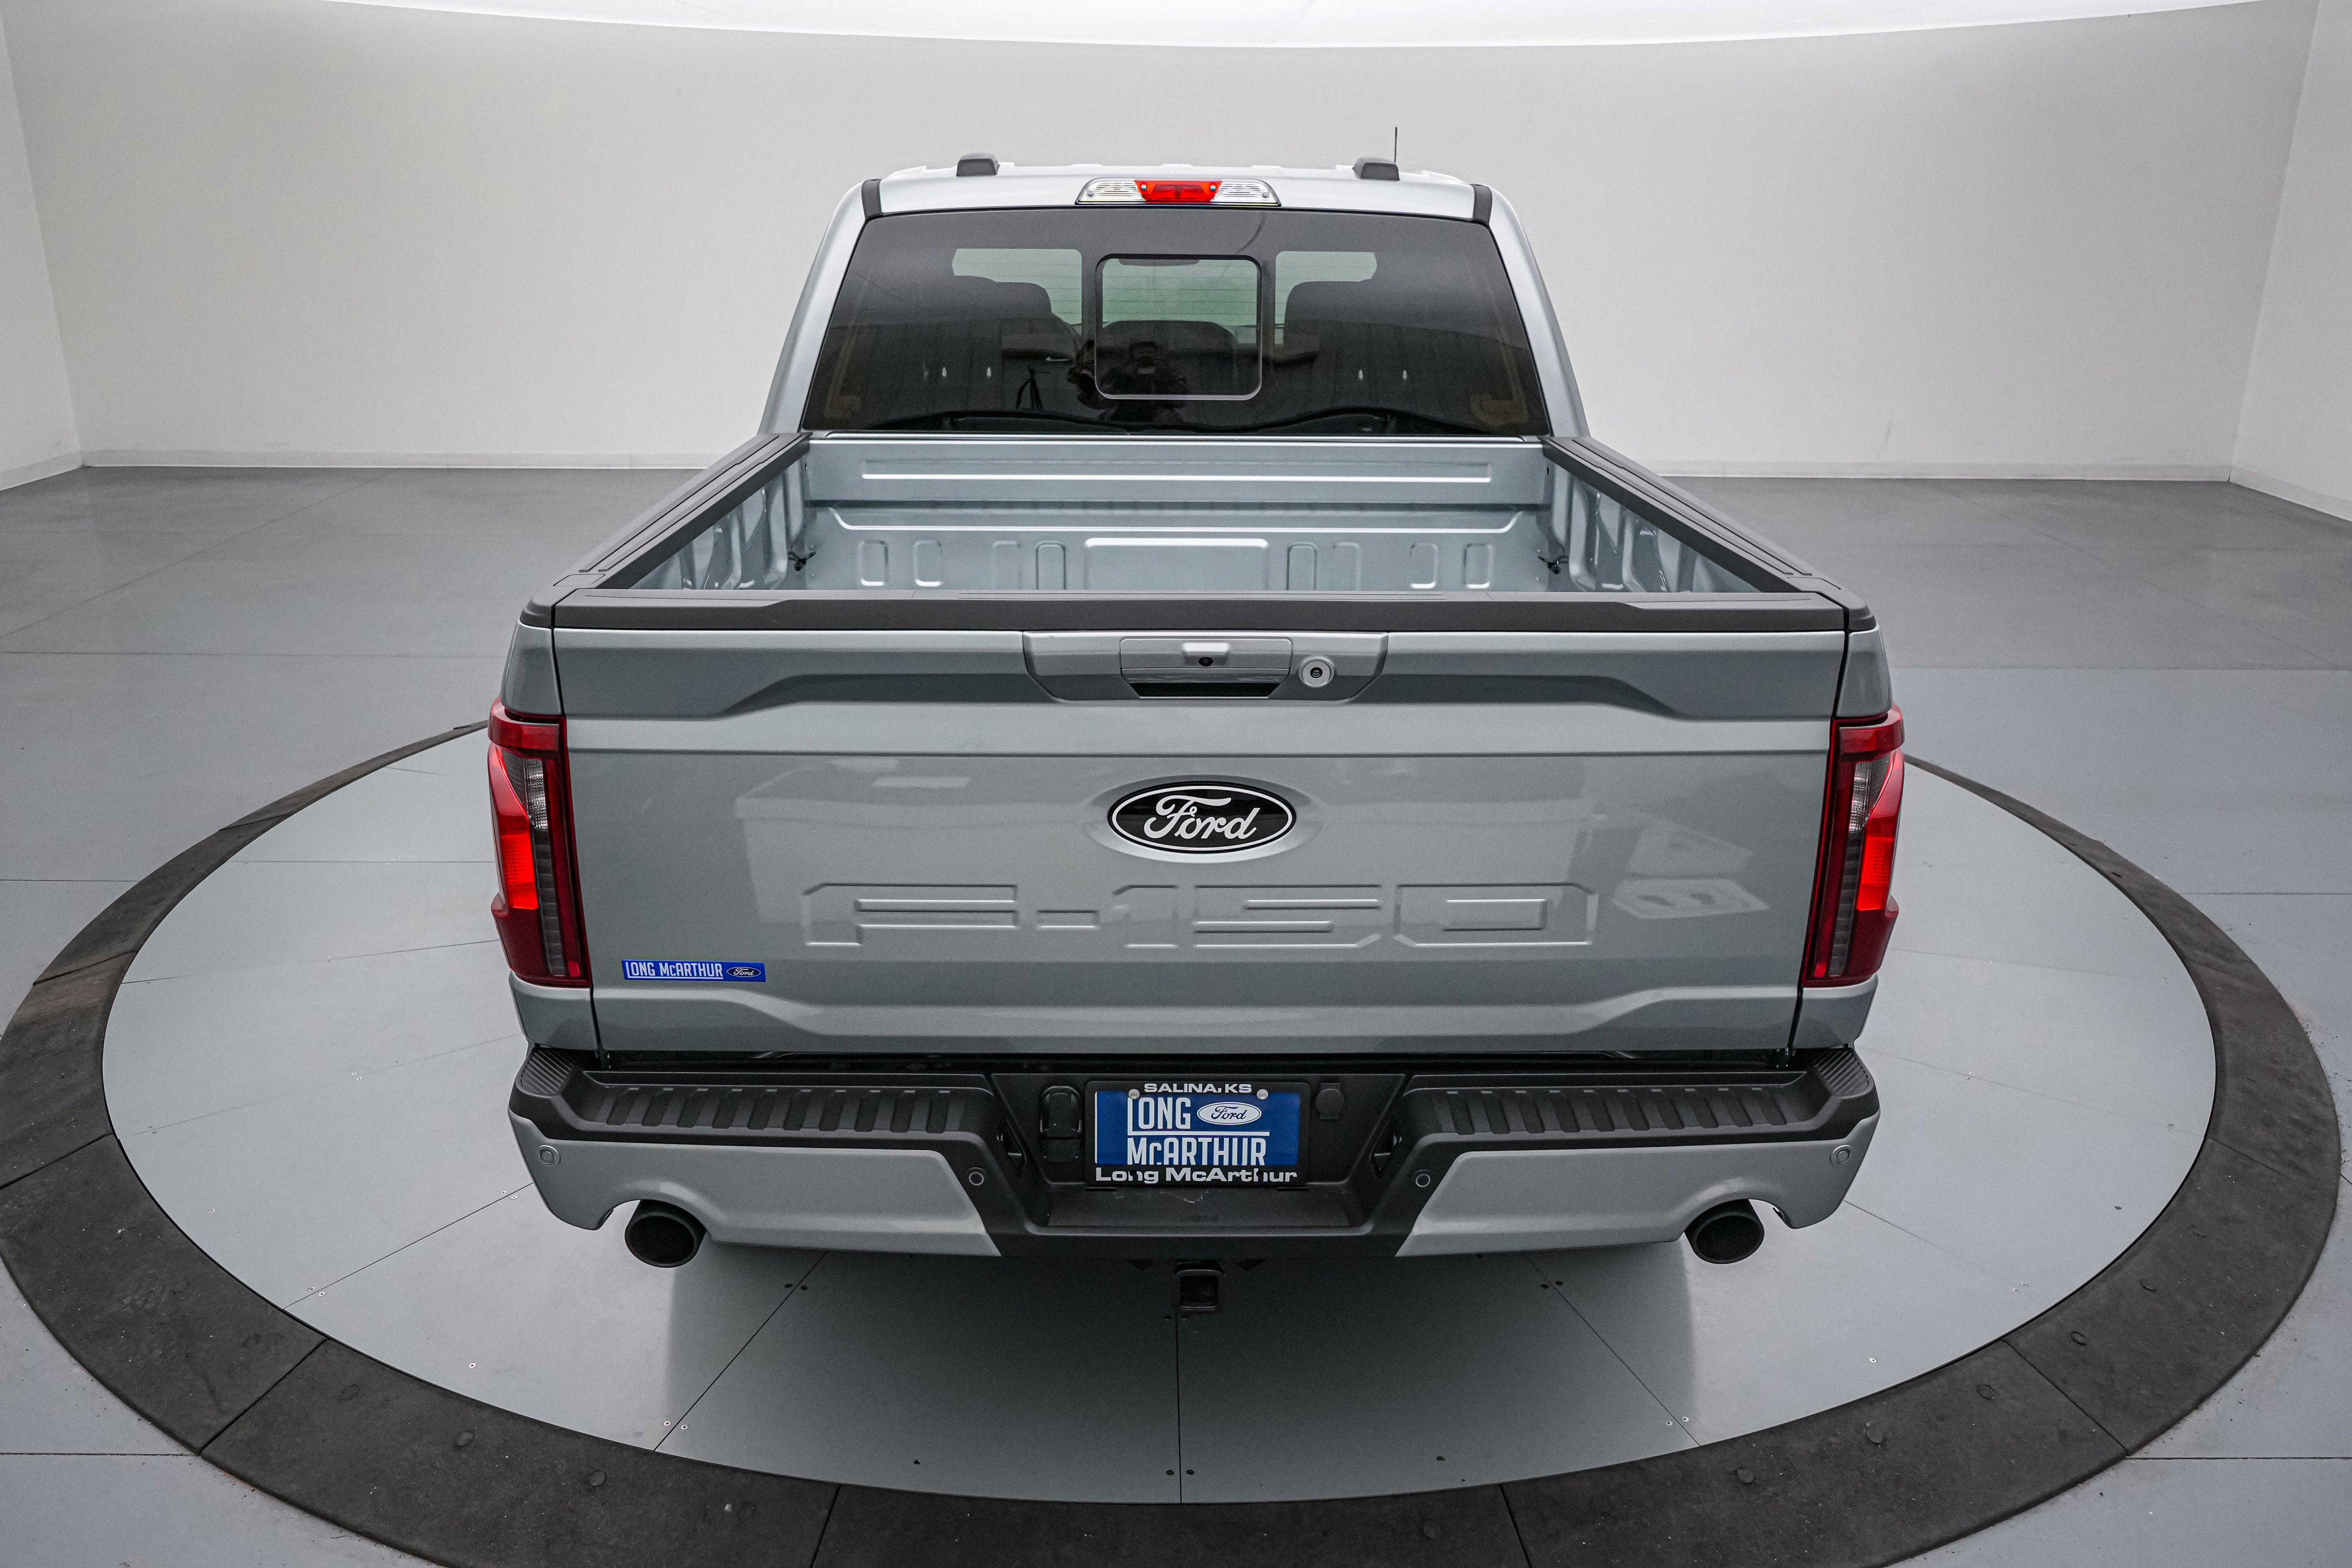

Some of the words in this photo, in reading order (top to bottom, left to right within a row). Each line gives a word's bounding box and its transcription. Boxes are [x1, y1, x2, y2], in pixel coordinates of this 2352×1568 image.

[1144, 795, 1261, 839] Ford
[625, 962, 656, 978] LONG
[659, 962, 723, 977] McARTHUR
[733, 968, 755, 976] Ford
[1144, 1083, 1222, 1093] SALINA,
[1225, 1084, 1252, 1093] KS
[1127, 1097, 1191, 1136] LONG
[1211, 1107, 1247, 1120] Ford
[1127, 1137, 1266, 1166] McARTHUR
[1096, 1167, 1159, 1184] Long
[1166, 1167, 1297, 1182] McArthur
